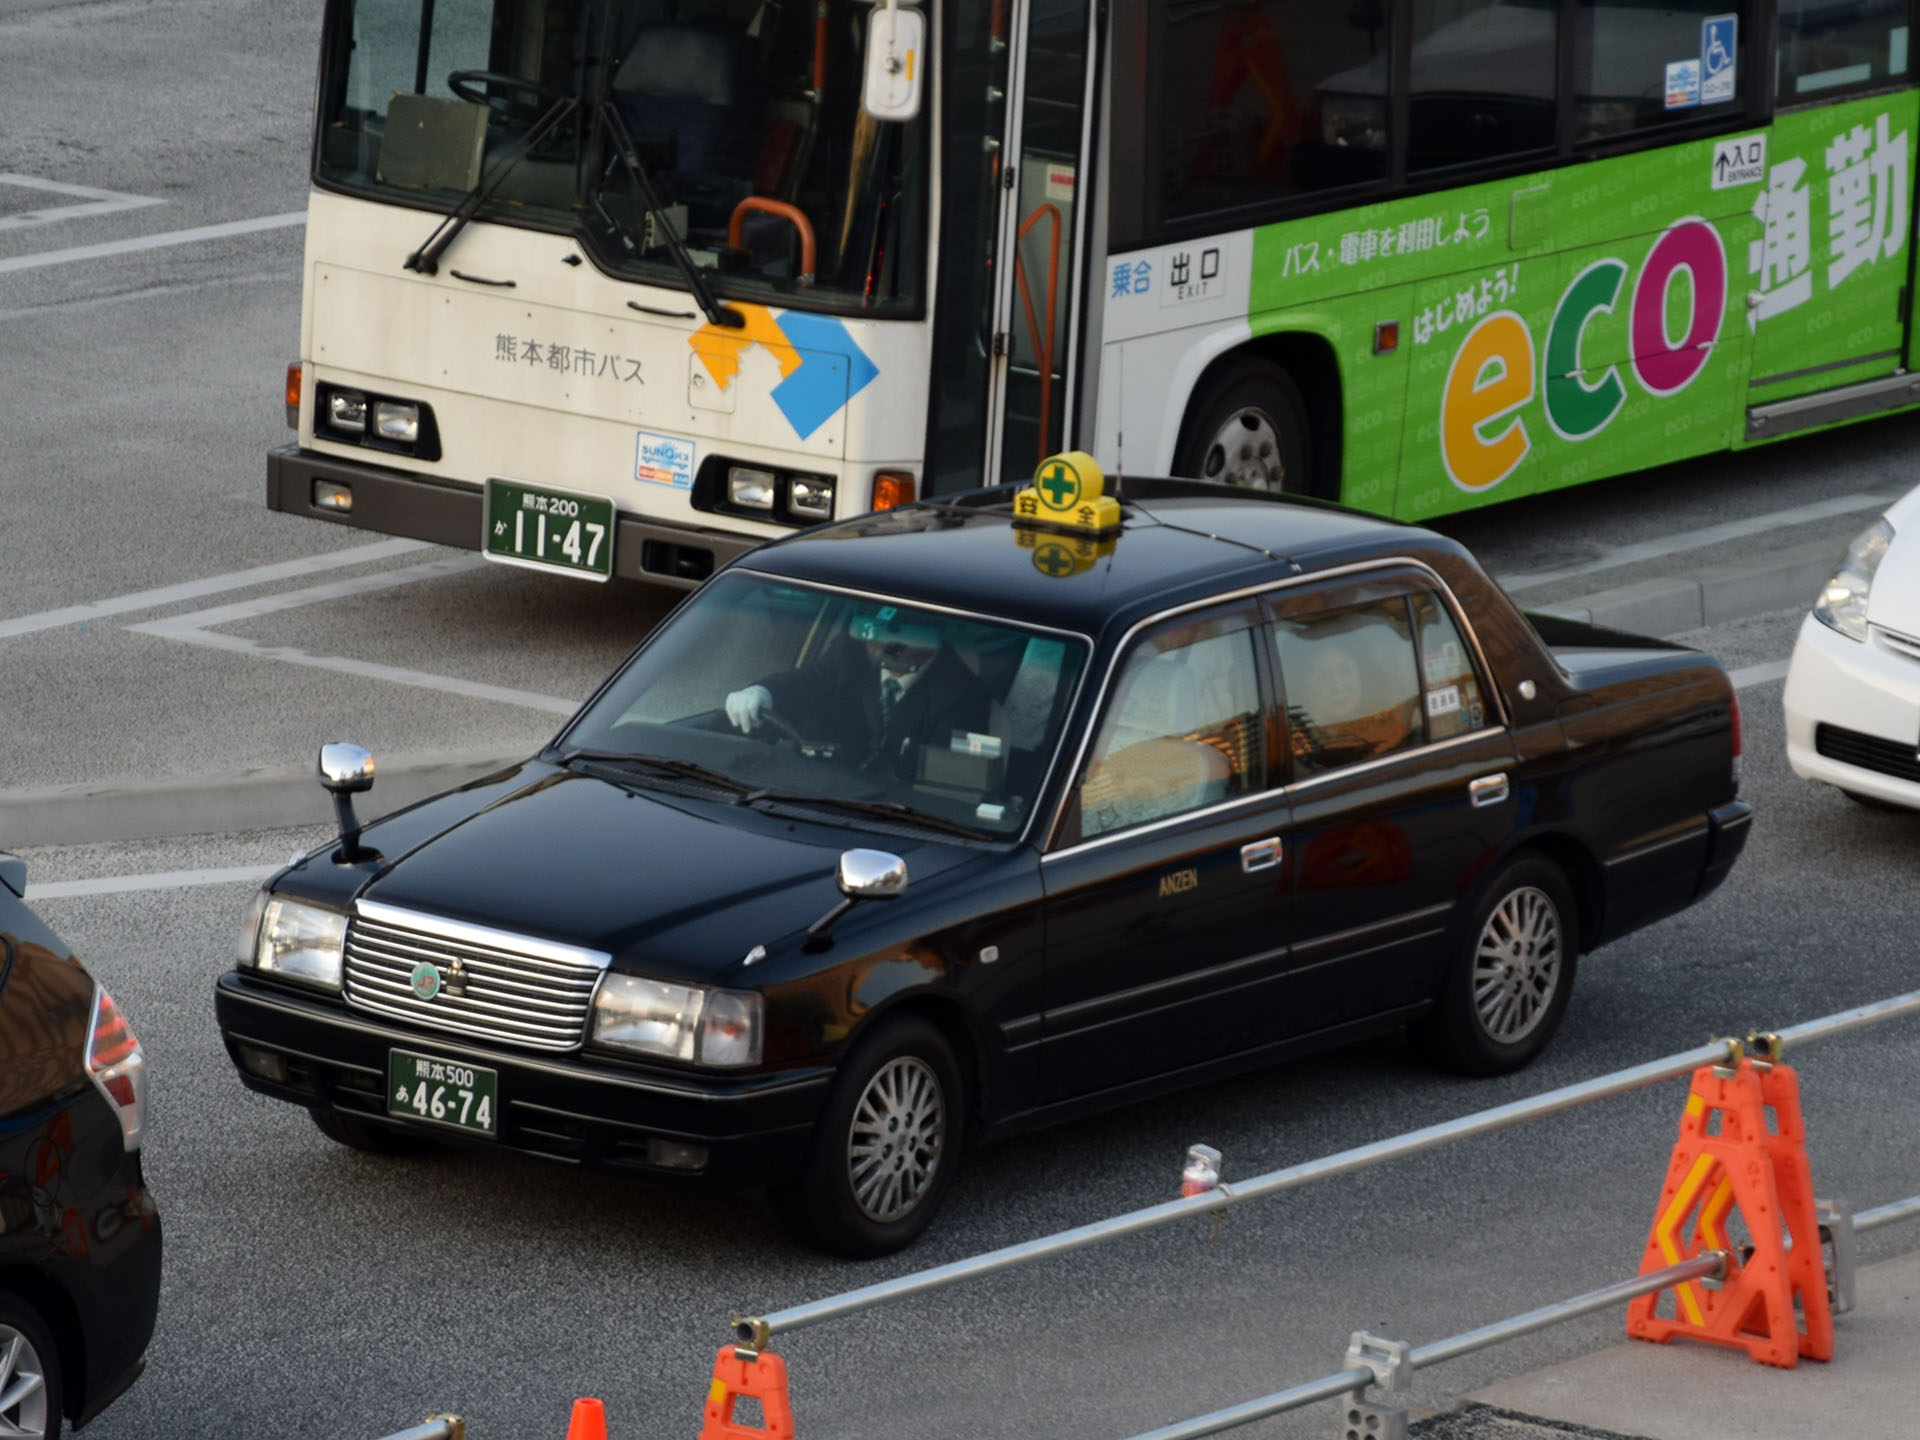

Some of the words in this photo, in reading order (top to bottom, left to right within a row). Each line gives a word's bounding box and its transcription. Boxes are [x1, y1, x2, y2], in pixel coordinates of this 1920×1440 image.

[1731, 142, 1761, 167] 入口
[1282, 208, 1490, 278] バス・電車を利用しよう
[1746, 112, 1908, 336] 通勤
[1112, 260, 1152, 298] 乗合
[1171, 247, 1219, 287] 出口
[1178, 281, 1208, 300] EXIT
[495, 332, 645, 385] 熊本都市バス
[1440, 215, 1728, 493] eco
[523, 492, 579, 517] 熊本200
[494, 520, 508, 535] か
[515, 509, 605, 567] 11-47
[1158, 867, 1198, 897] ANZEN
[416, 1058, 474, 1088] 熊本500
[395, 1084, 409, 1103] あ
[412, 1081, 492, 1130] 46-74
